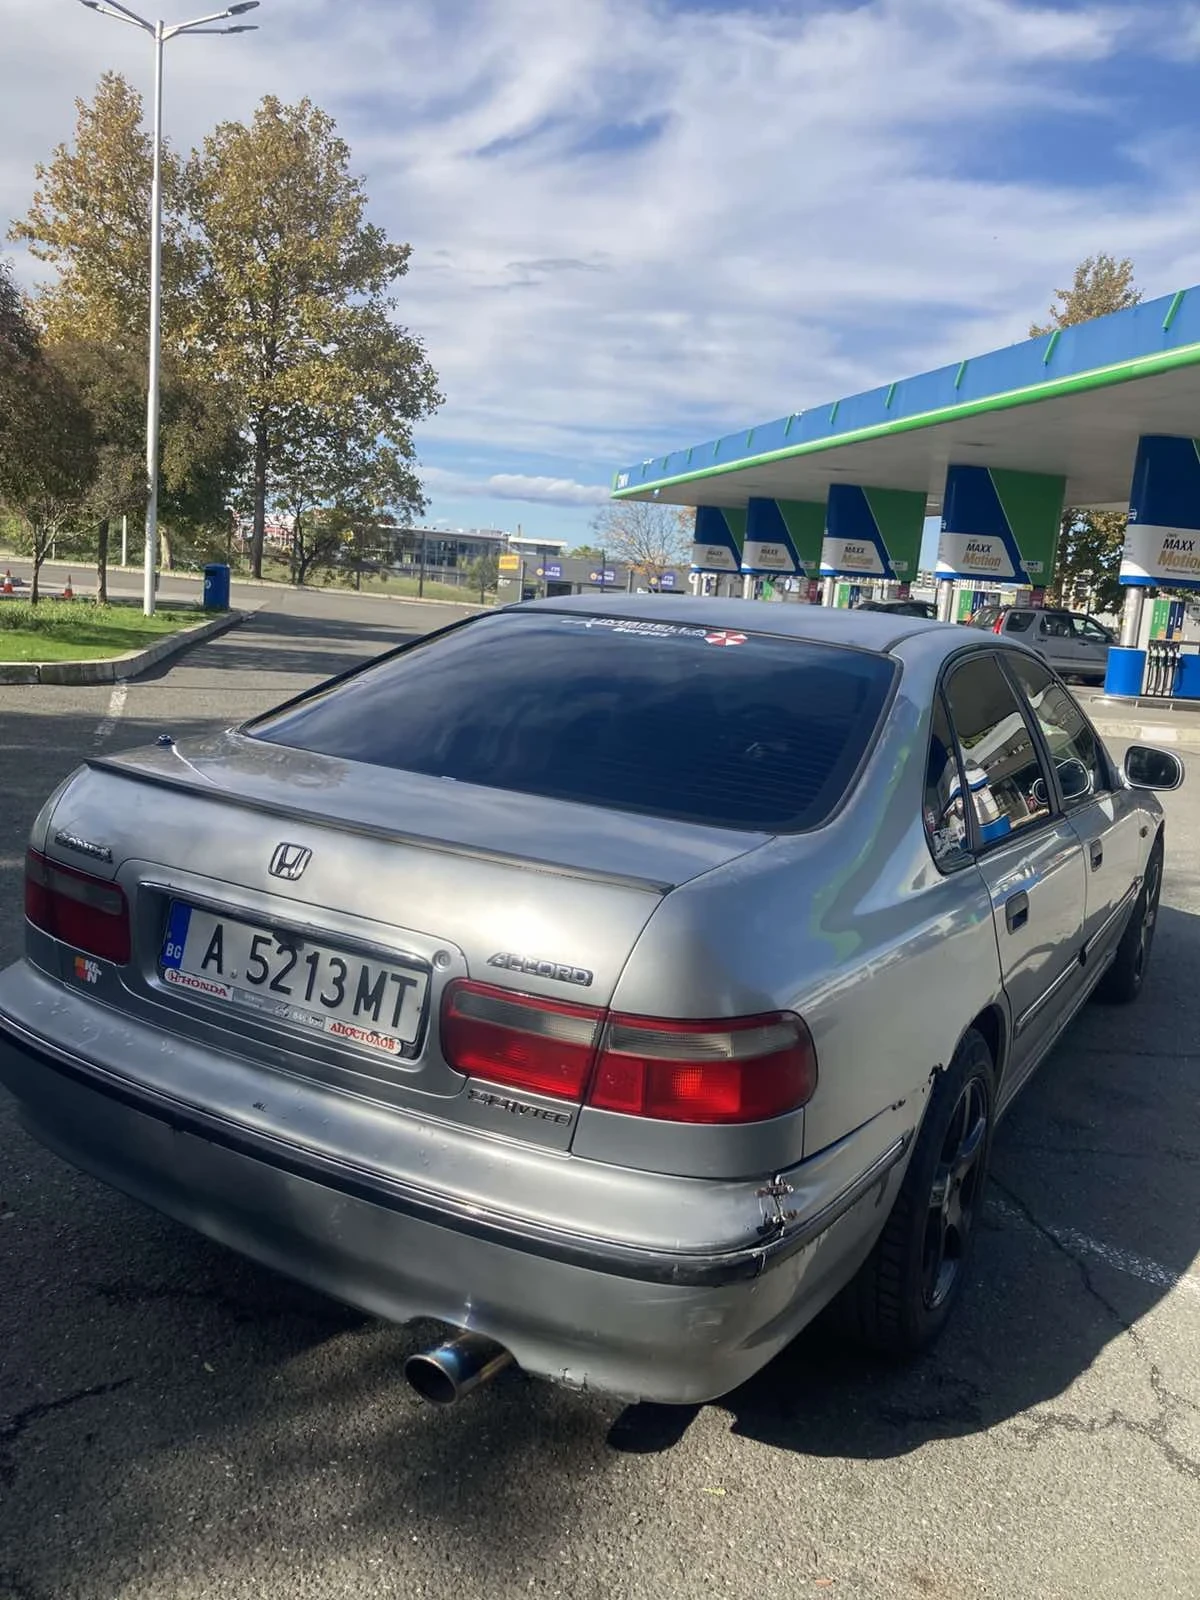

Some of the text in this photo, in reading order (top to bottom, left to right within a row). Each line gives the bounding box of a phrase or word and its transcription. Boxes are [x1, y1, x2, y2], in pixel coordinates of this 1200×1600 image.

[966, 543, 992, 553] MAXX
[1163, 538, 1195, 551] MAXX
[962, 552, 1001, 568] Motion
[165, 942, 182, 960] BG
[201, 924, 418, 1028] A 5213 MT
[487, 952, 593, 986] ACCORD
[181, 976, 228, 997] HONDA
[330, 1022, 395, 1050] АПОСТОЛОВ
